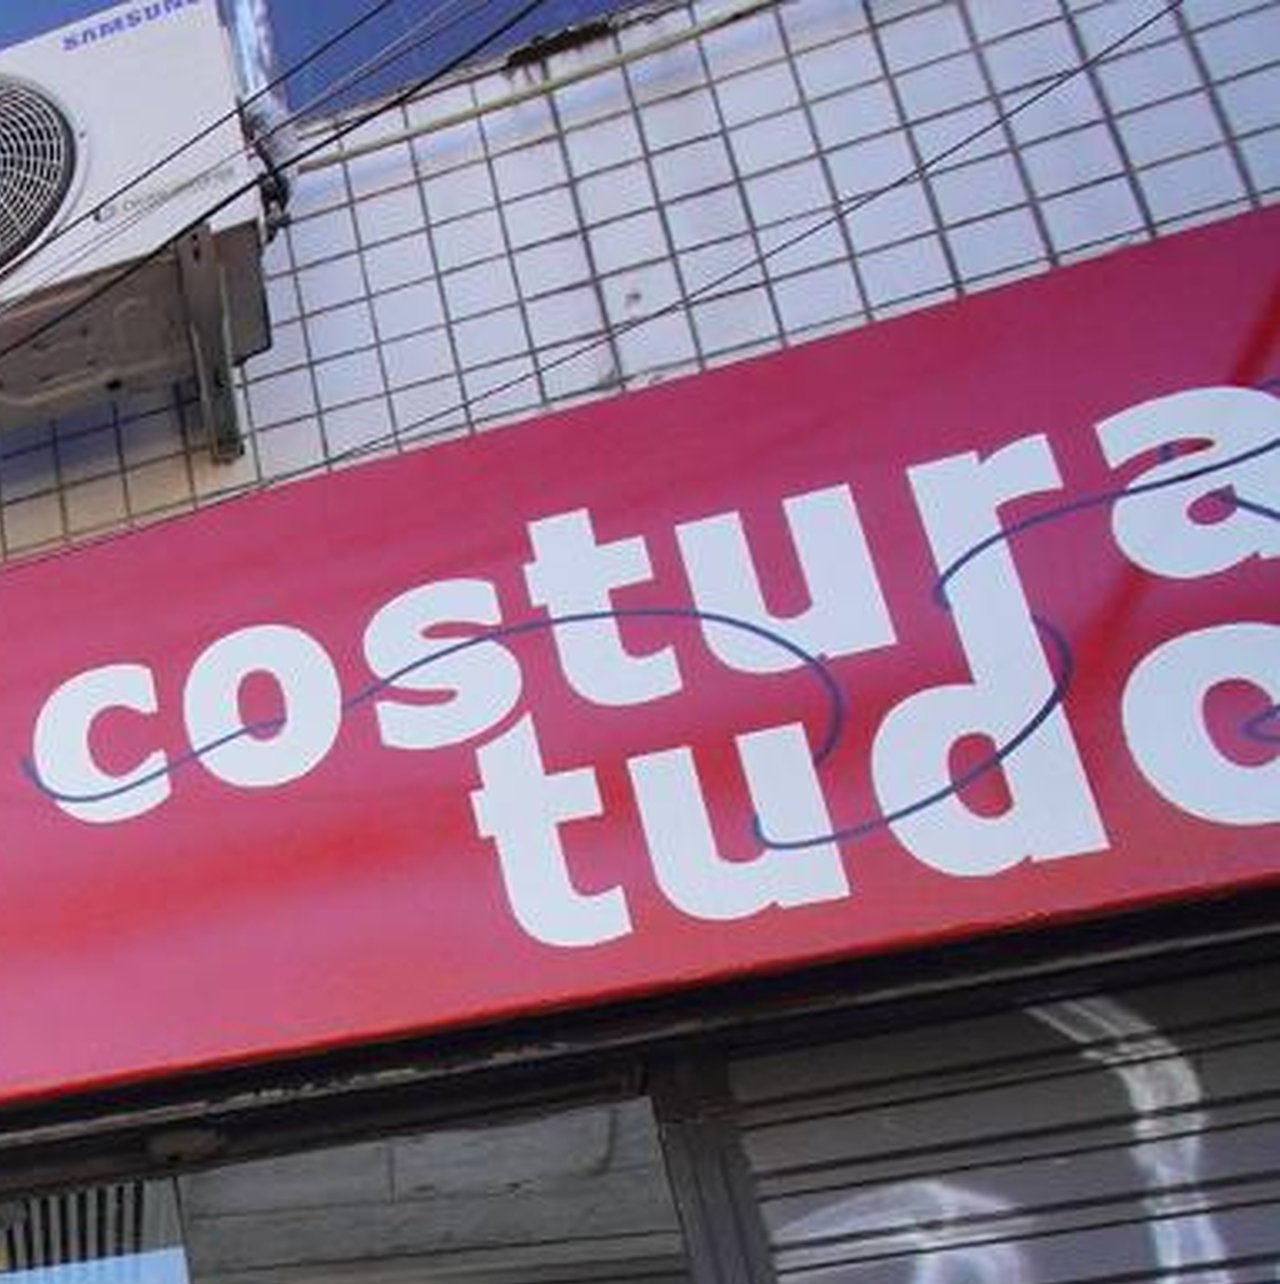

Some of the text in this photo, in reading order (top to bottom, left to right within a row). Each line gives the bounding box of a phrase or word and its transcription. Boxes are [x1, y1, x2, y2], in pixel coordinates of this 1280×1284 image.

[60, 0, 200, 50] SAMSUN
[32, 384, 1280, 824] costura
[469, 580, 1280, 948] tudo
